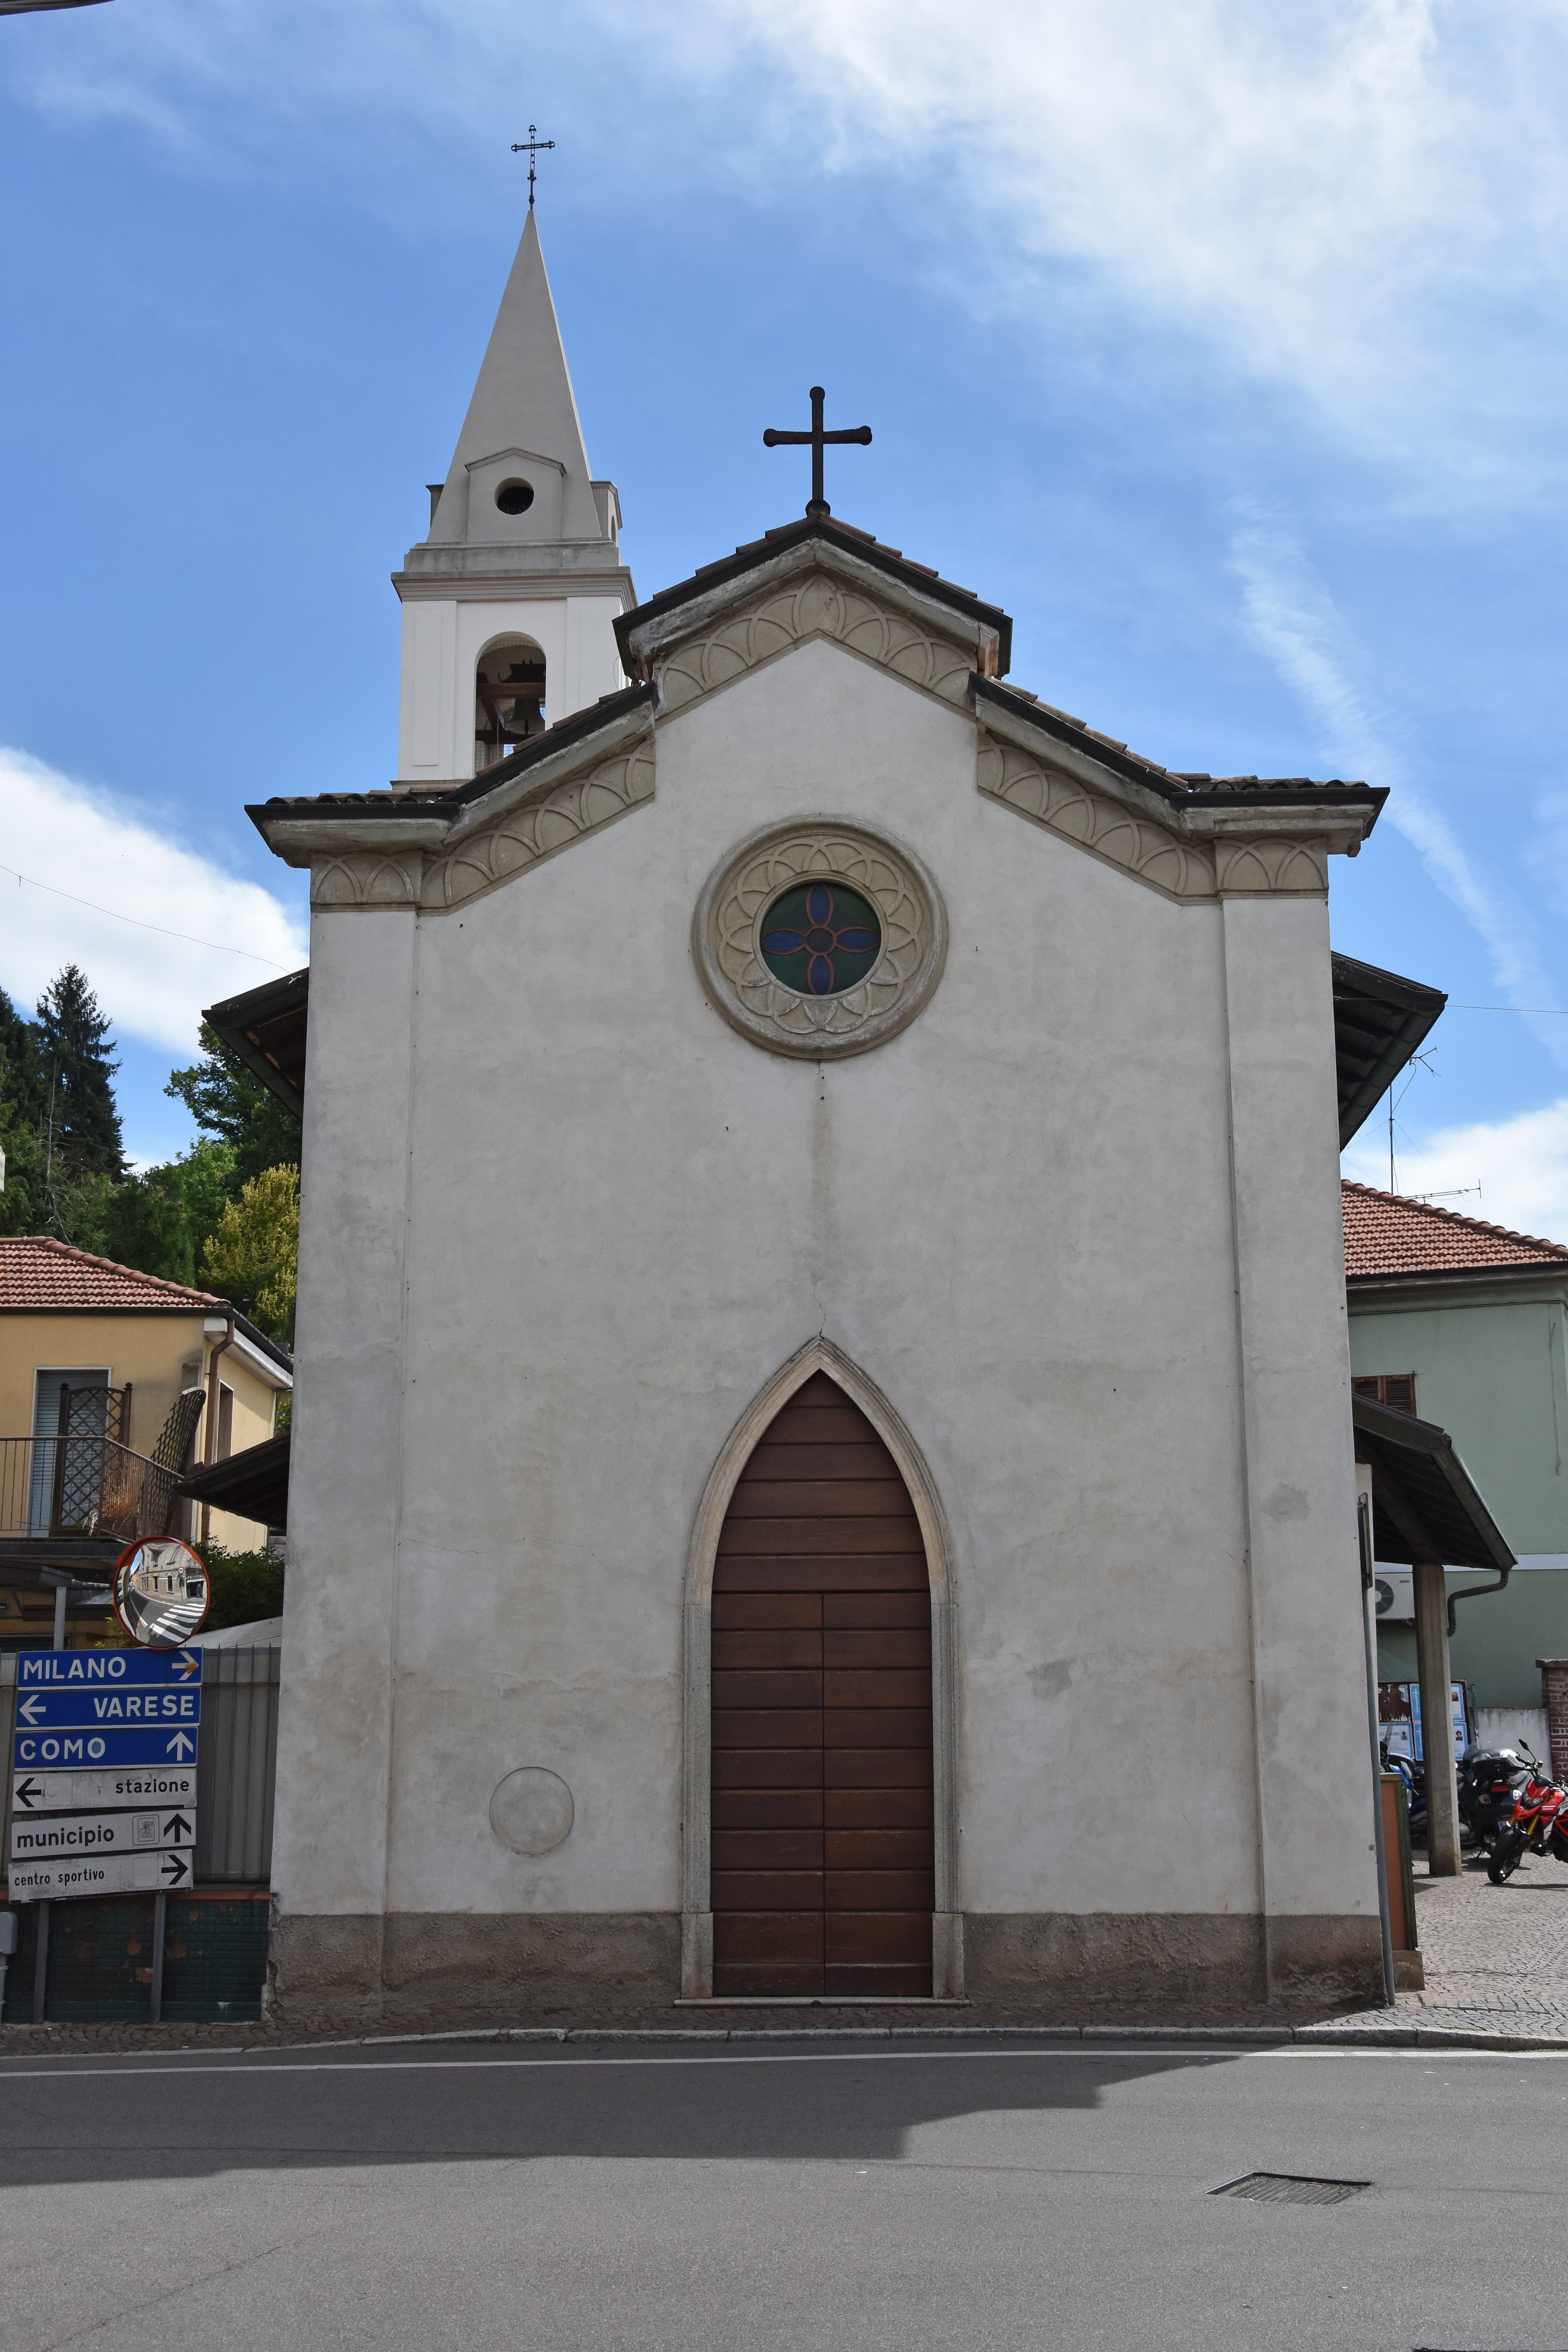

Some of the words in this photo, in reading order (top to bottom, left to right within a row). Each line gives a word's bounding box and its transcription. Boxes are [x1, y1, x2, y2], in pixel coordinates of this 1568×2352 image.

[24, 1656, 126, 1679] MILANO
[94, 1695, 194, 1718] VARESE
[20, 1737, 105, 1760] COMO
[116, 1778, 189, 1794] stazione
[17, 1825, 114, 1848] municipio
[14, 1873, 50, 1886] centro
[58, 1868, 105, 1886] sportivo
